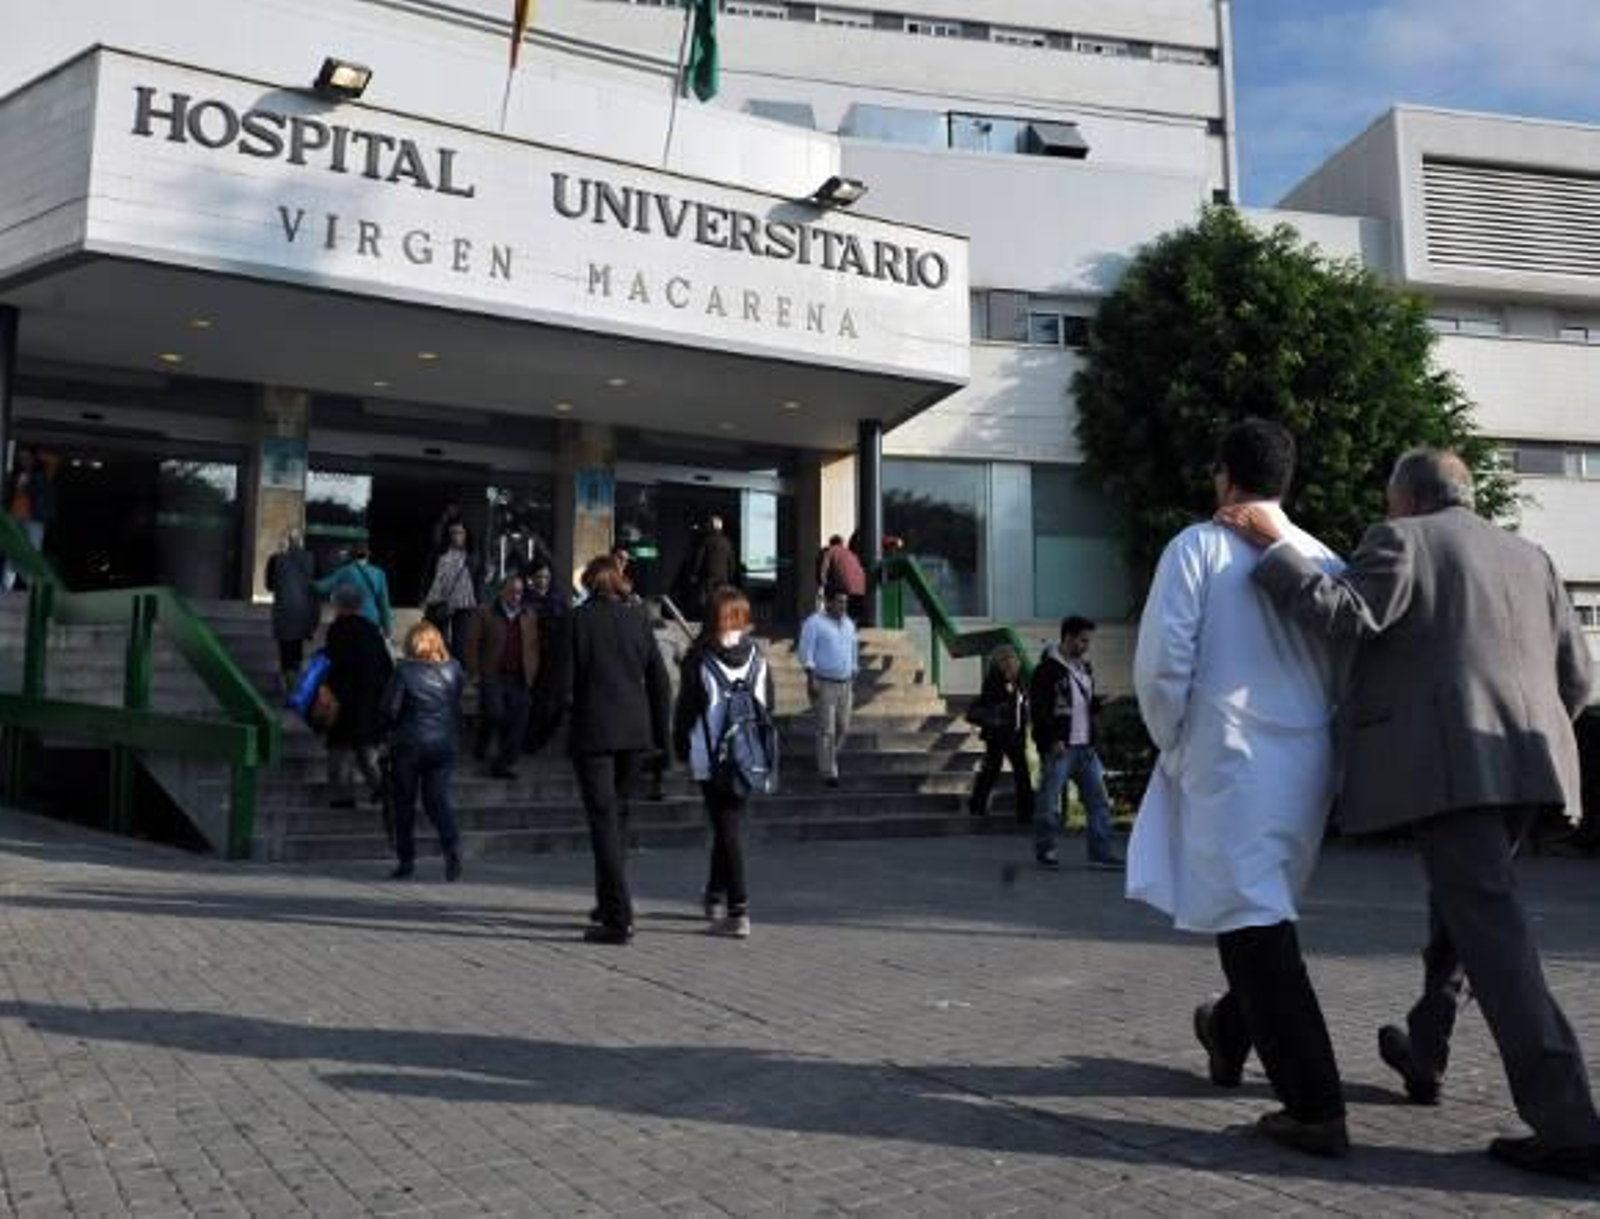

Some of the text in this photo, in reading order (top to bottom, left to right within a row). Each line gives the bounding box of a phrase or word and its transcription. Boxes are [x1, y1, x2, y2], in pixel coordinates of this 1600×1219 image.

[131, 86, 949, 290] HOSPITAL UNIVERSITARIO
[278, 206, 860, 340] VIRGEN MACARENA
